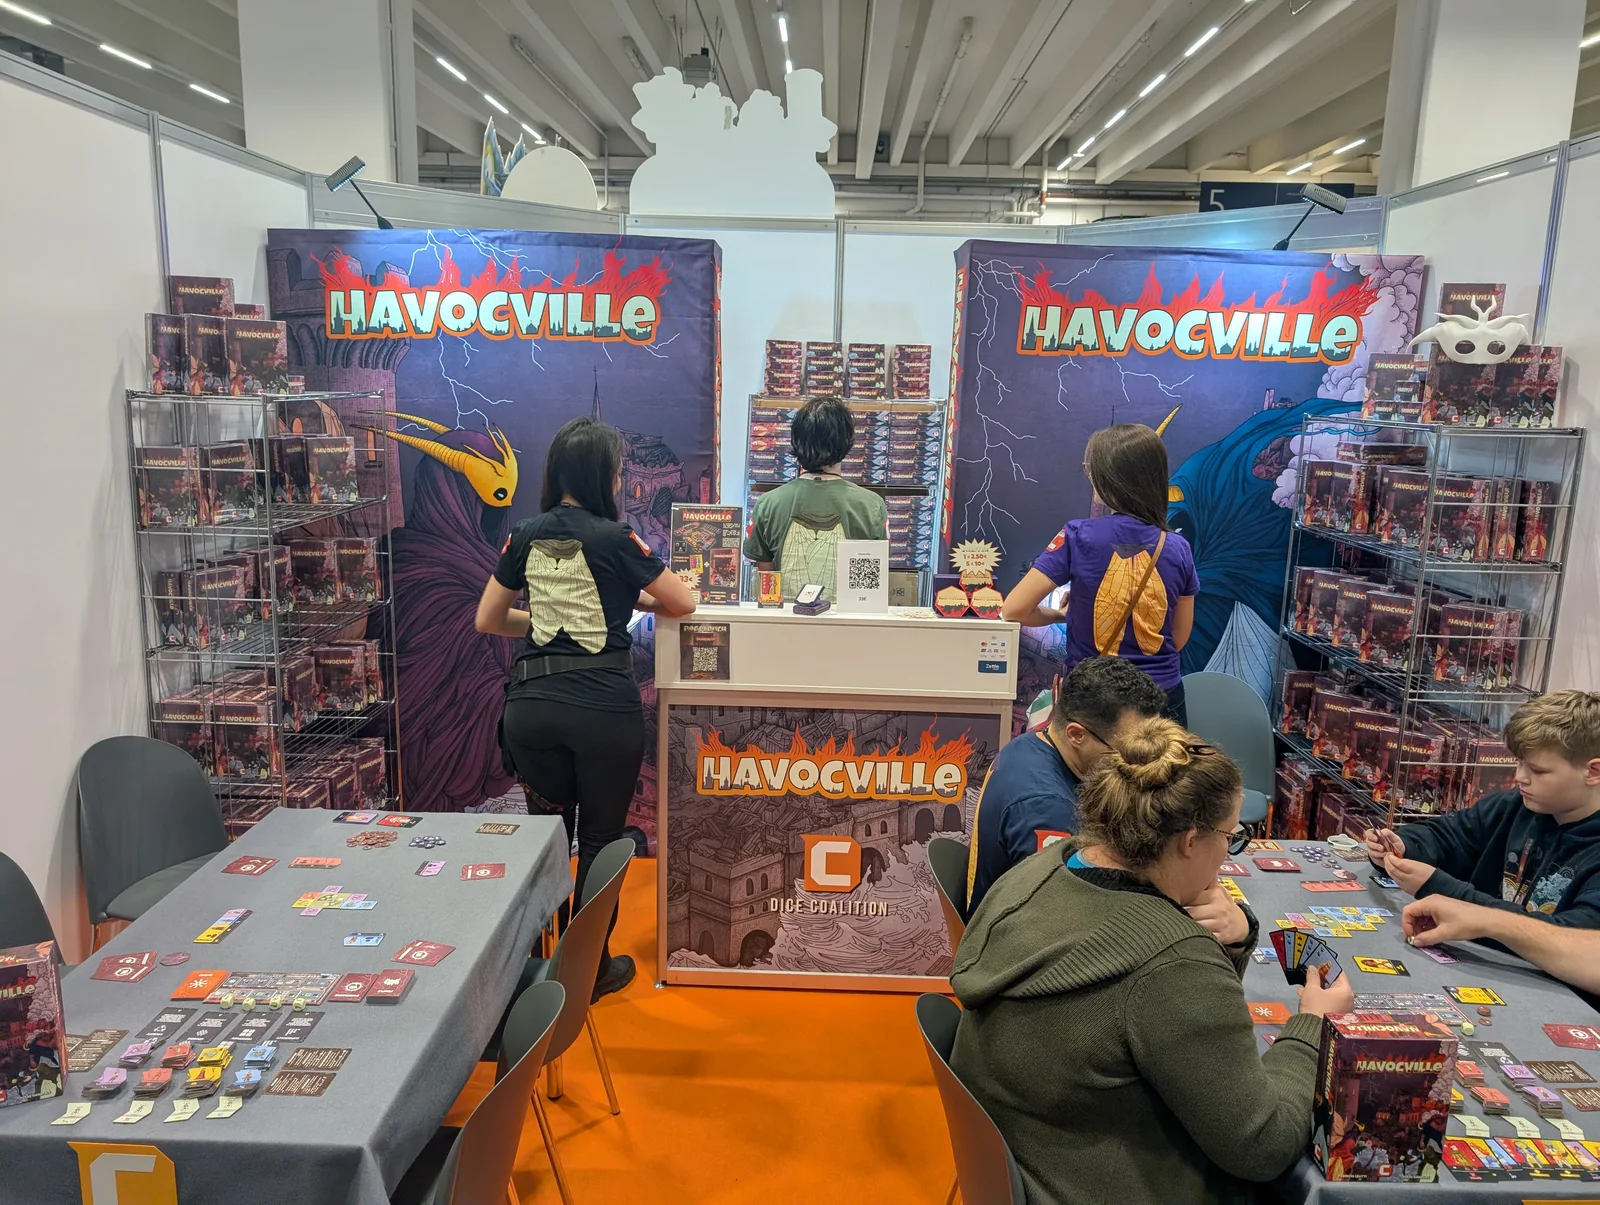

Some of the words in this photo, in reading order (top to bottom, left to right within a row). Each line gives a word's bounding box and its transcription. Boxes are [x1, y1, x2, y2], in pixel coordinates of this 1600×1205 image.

[1209, 189, 1225, 211] 5
[770, 898, 804, 914] DICE
[811, 899, 889, 917] COALITION
